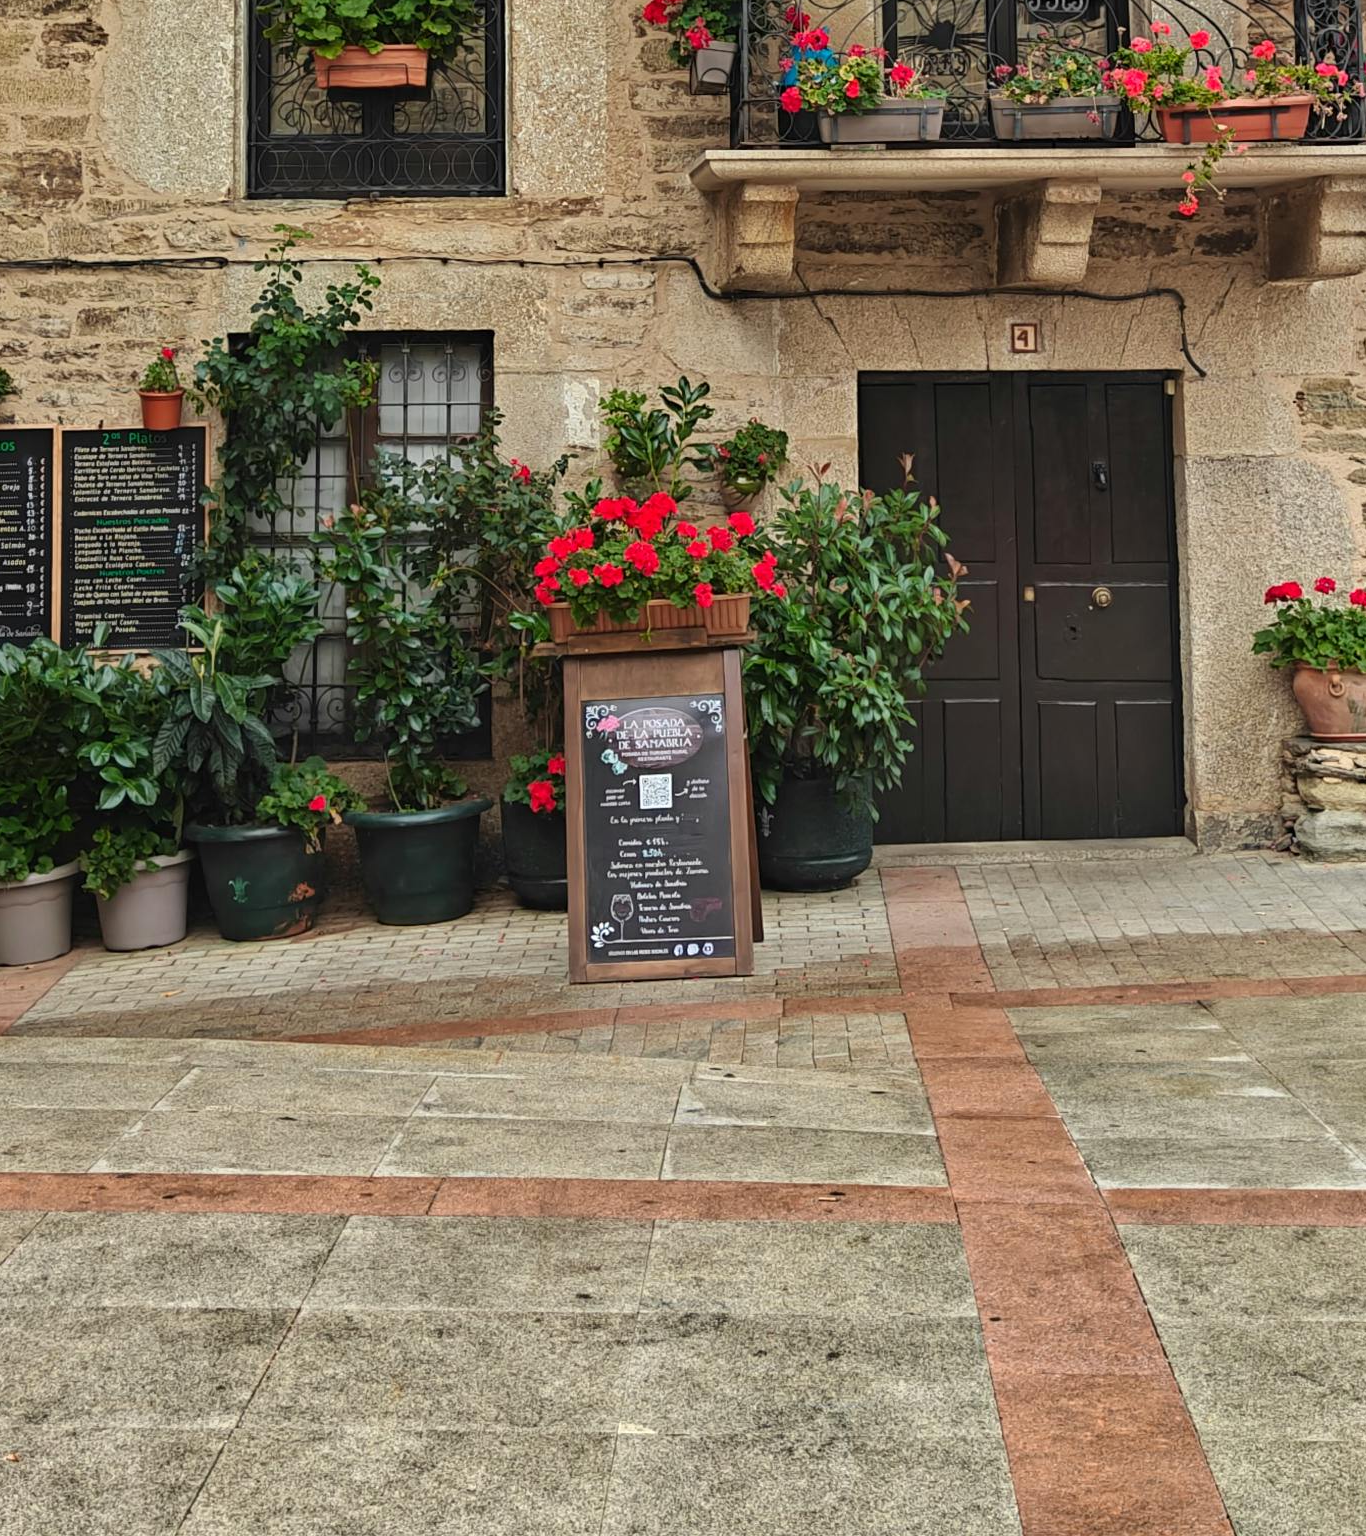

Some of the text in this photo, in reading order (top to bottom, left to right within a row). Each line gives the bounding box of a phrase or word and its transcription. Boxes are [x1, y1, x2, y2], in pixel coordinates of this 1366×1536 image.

[1017, 330, 1028, 347] 4
[623, 718, 685, 729] LA POSADA
[634, 729, 649, 739] LA
[653, 728, 692, 737] PUEBLA
[619, 738, 692, 750] DE SANABRIA
